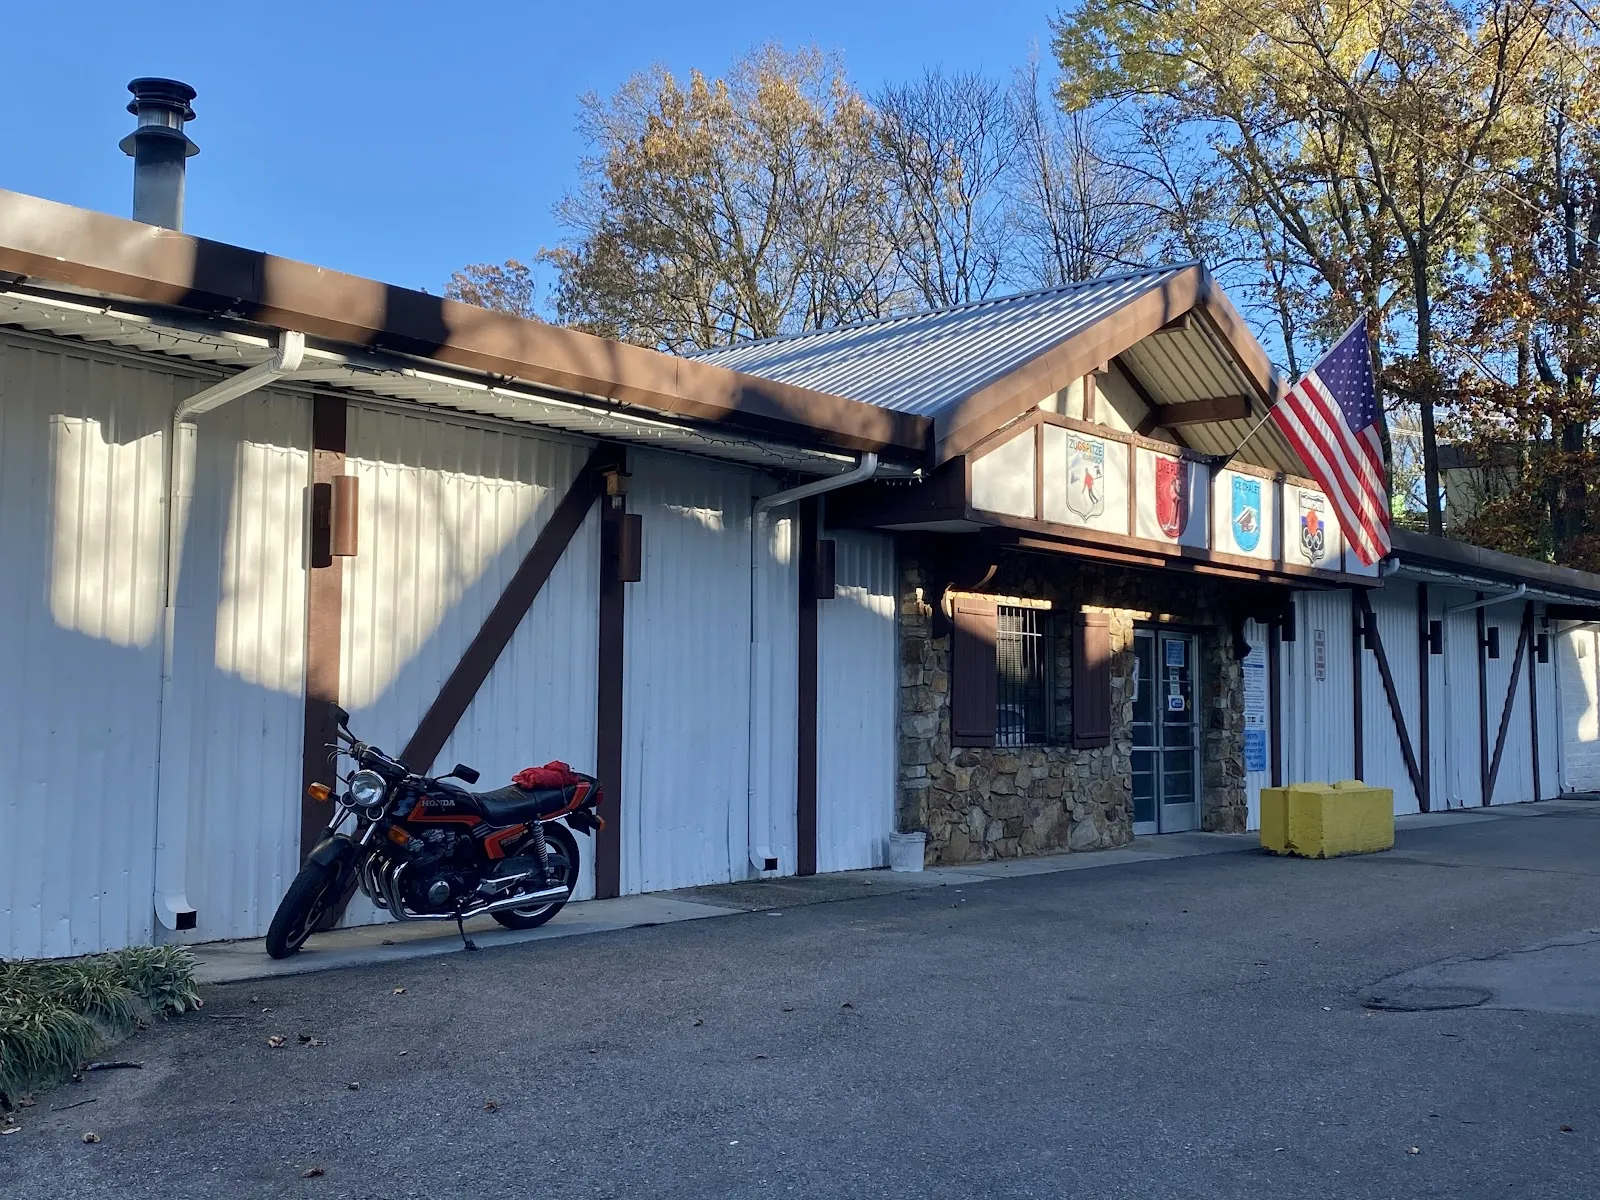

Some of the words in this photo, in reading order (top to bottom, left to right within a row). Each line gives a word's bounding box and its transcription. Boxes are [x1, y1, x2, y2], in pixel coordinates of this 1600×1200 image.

[1069, 438, 1102, 457] ZUGSPITZE
[1242, 482, 1260, 495] CHALET
[421, 799, 456, 807] HONDA
